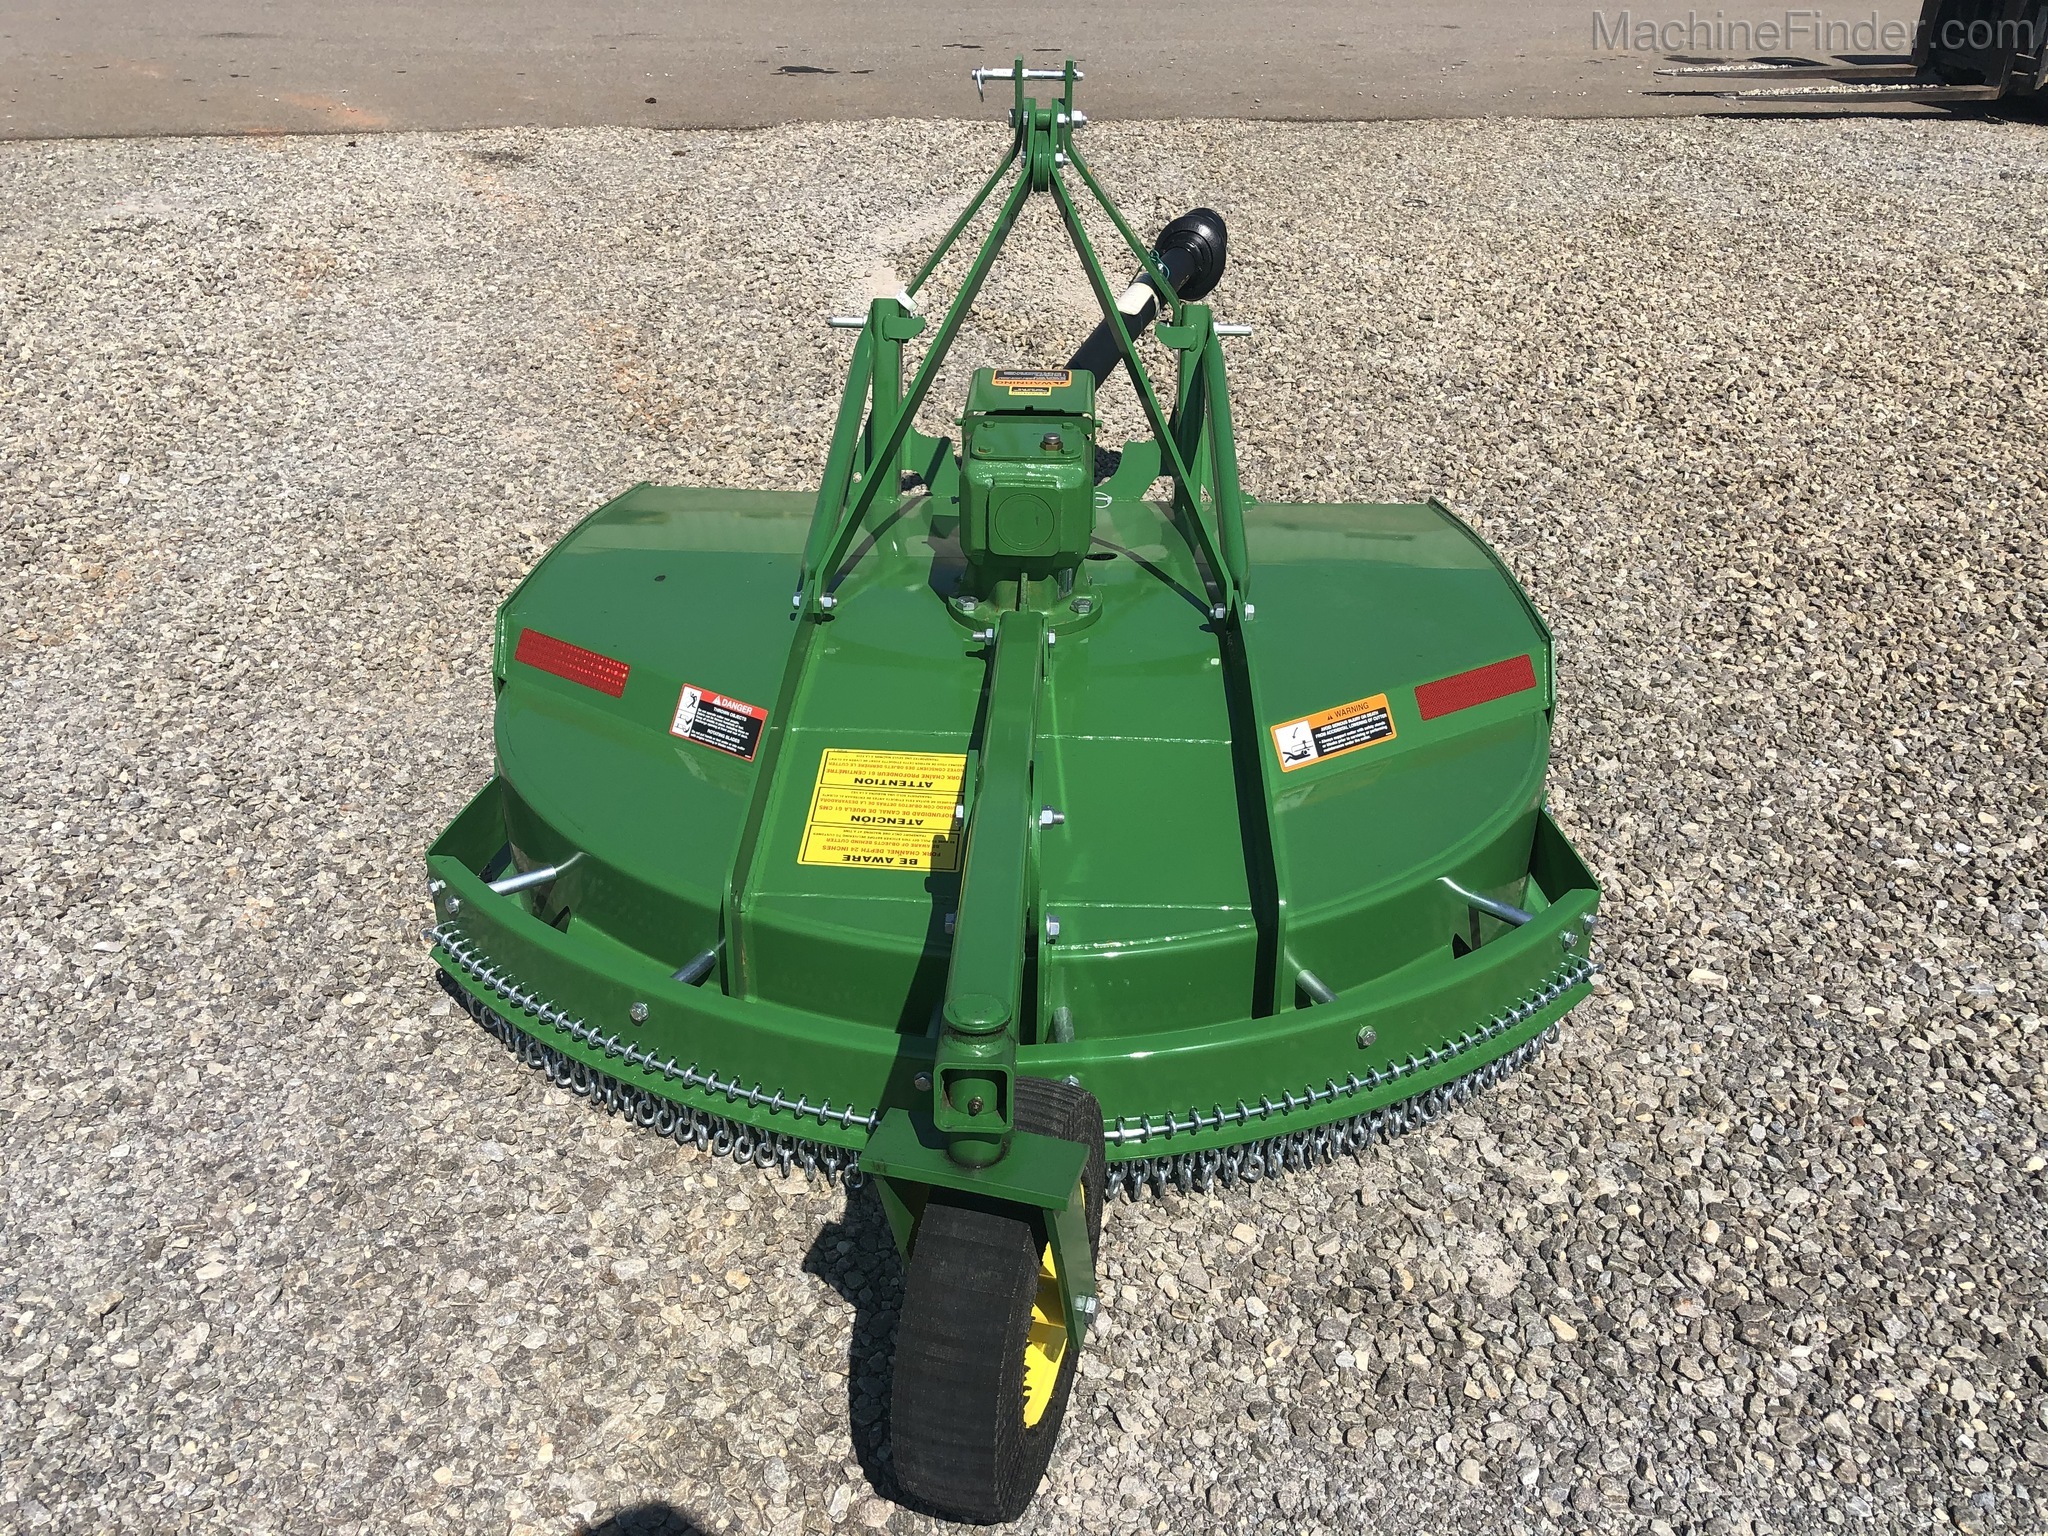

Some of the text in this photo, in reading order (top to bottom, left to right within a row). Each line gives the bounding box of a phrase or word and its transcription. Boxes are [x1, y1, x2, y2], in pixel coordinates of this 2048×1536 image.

[721, 698, 753, 716] DANGER
[1334, 702, 1369, 717] WARNING
[854, 778, 933, 788] ATTENTION
[851, 816, 924, 825] ATENCIÓN
[842, 855, 894, 864] AWARE
